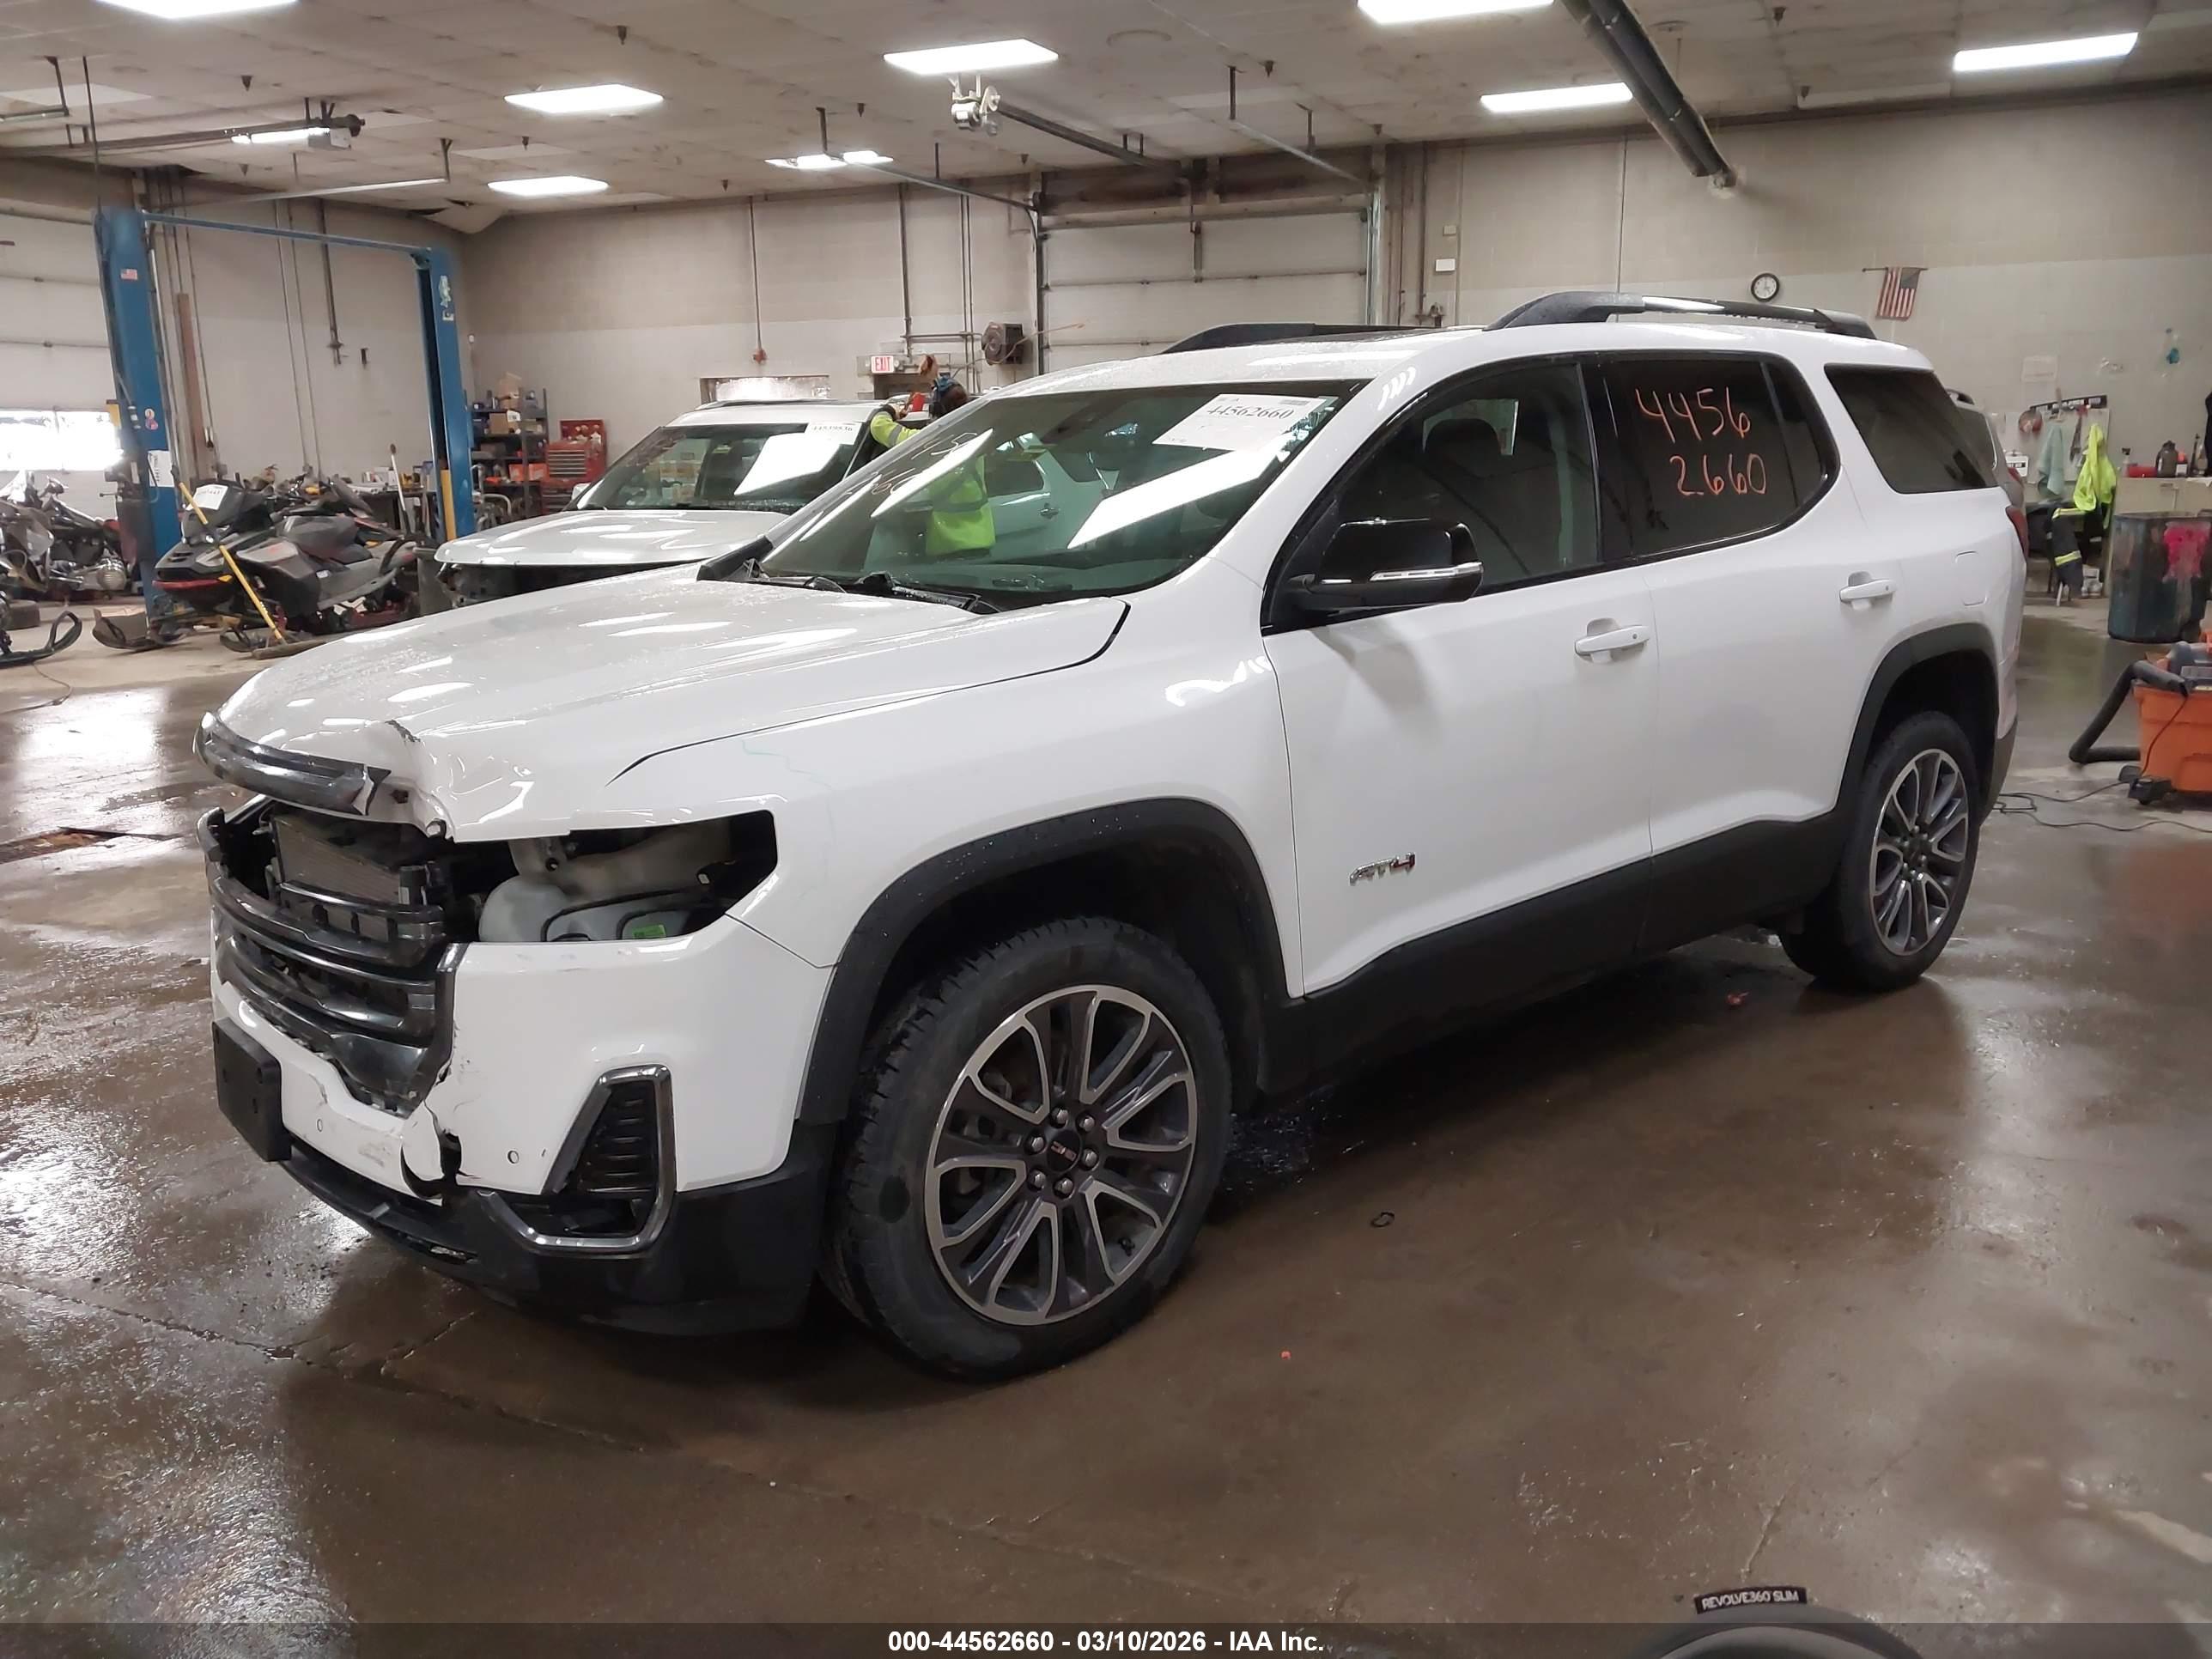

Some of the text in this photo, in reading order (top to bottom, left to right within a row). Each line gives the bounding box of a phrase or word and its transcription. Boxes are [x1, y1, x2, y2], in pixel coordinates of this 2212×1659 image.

[875, 356, 890, 371] EXIT
[1206, 404, 1295, 420] 44562660
[1635, 386, 1751, 443] 4456
[1669, 453, 1766, 495] 2660
[1772, 1589, 1799, 1602] SLIM
